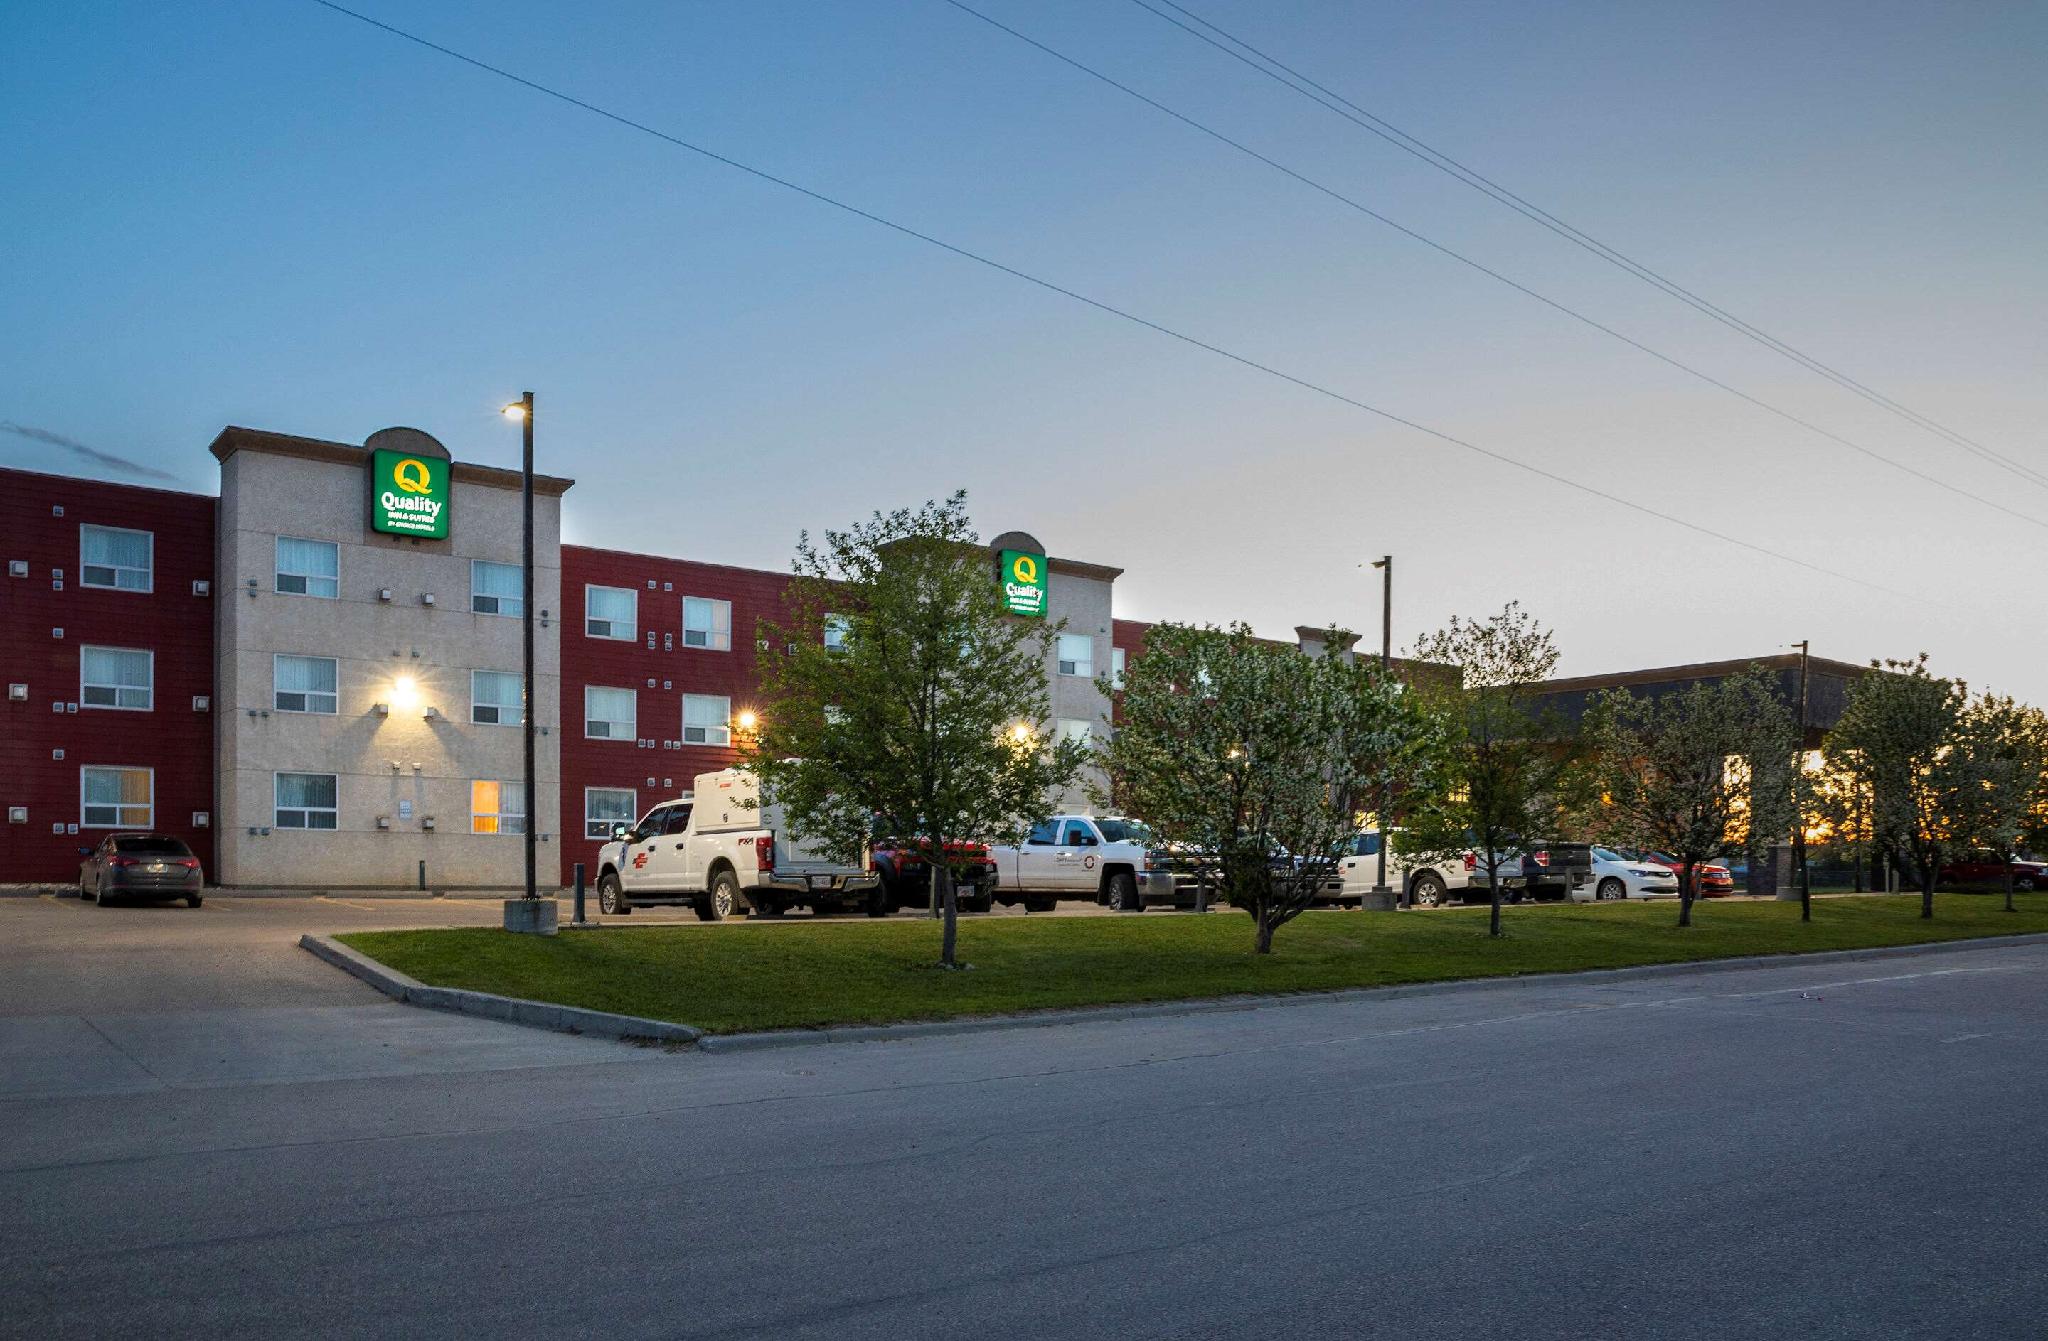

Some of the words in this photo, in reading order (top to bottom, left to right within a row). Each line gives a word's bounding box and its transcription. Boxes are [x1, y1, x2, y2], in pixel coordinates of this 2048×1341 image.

[394, 459, 432, 494] Q
[381, 491, 442, 517] Quality
[1014, 556, 1038, 583] Q
[1006, 582, 1043, 605] Quality
